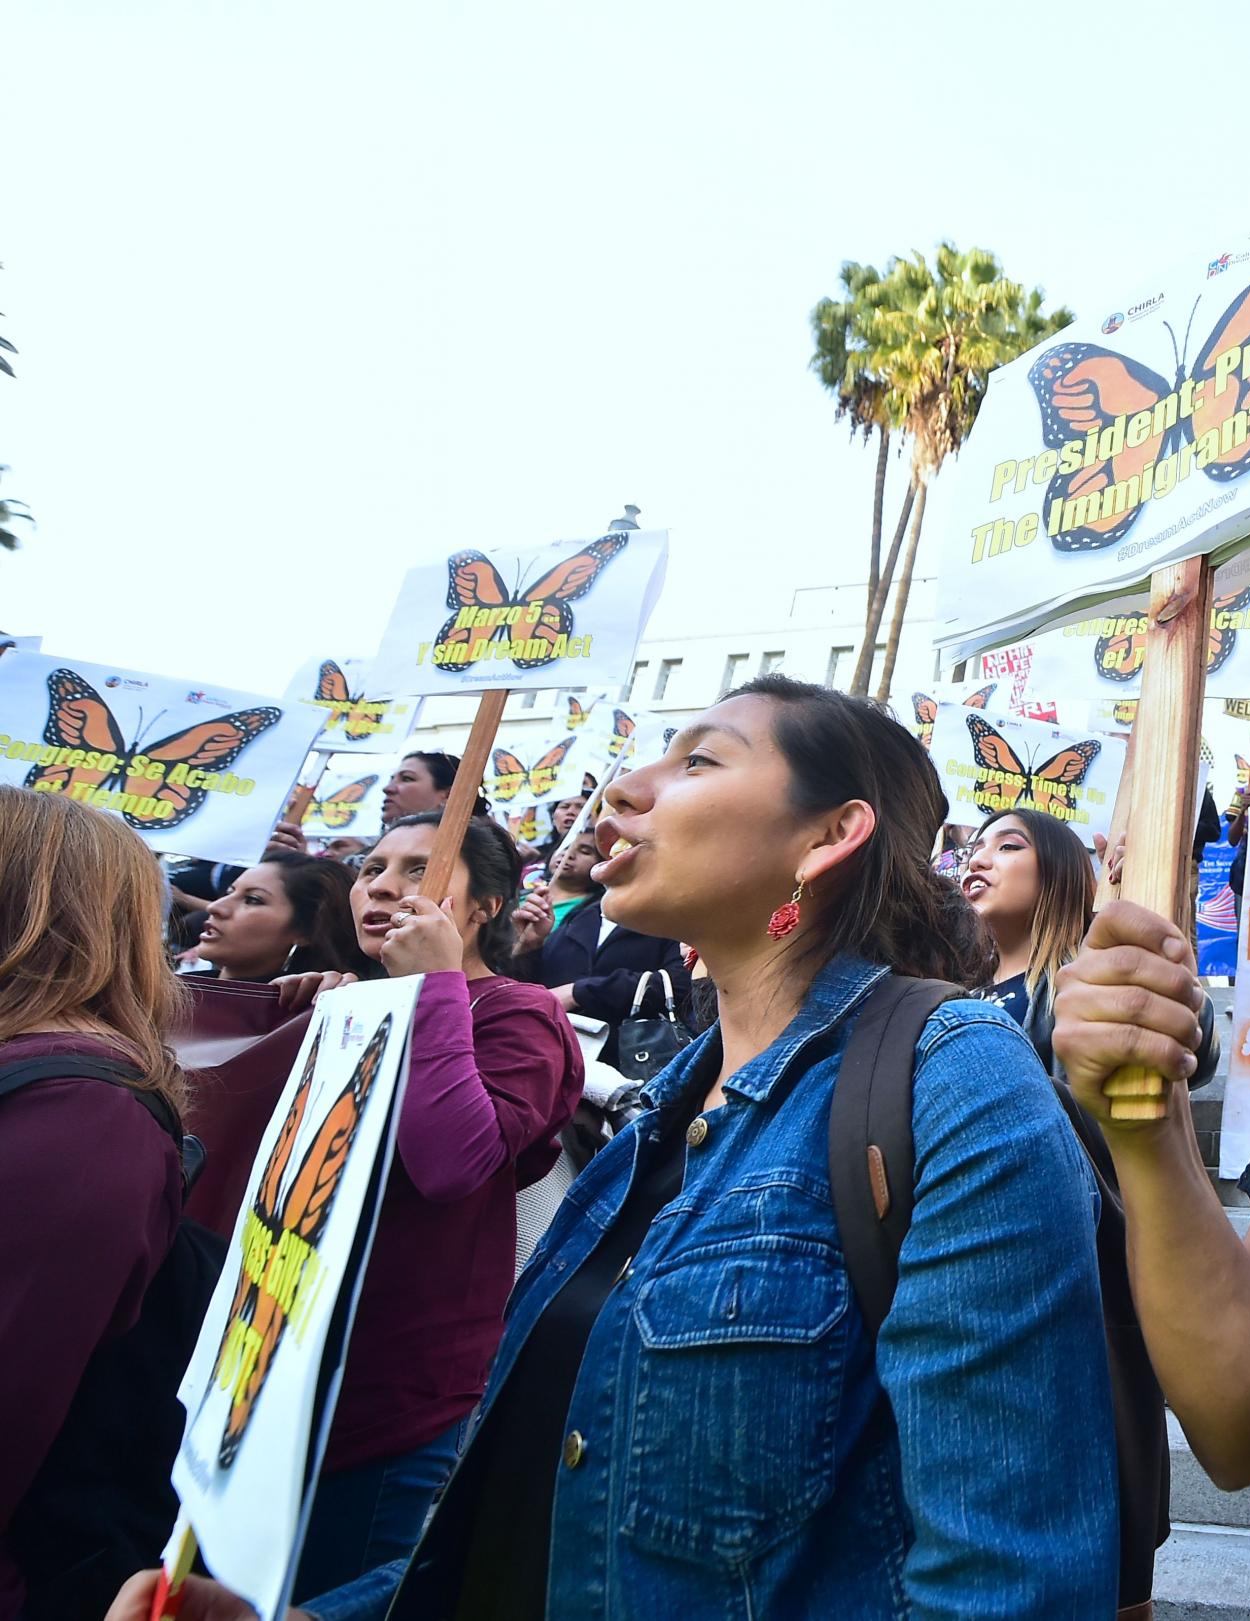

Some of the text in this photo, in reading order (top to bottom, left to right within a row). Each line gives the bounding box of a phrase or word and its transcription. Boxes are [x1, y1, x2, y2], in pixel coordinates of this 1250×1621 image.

[1127, 292, 1165, 316] CHIRLA
[989, 385, 1208, 504] President:
[970, 510, 1042, 565] The
[1117, 488, 1239, 562] #DreamActNow
[454, 605, 523, 629] Marzo
[416, 633, 594, 666] Y sin Dream Act
[126, 752, 166, 781] Se
[166, 762, 256, 796] Acabo
[945, 758, 1028, 789] Congress:
[1030, 774, 1069, 797] Time
[71, 779, 175, 819] Tiempo
[955, 785, 1017, 811] Protect
